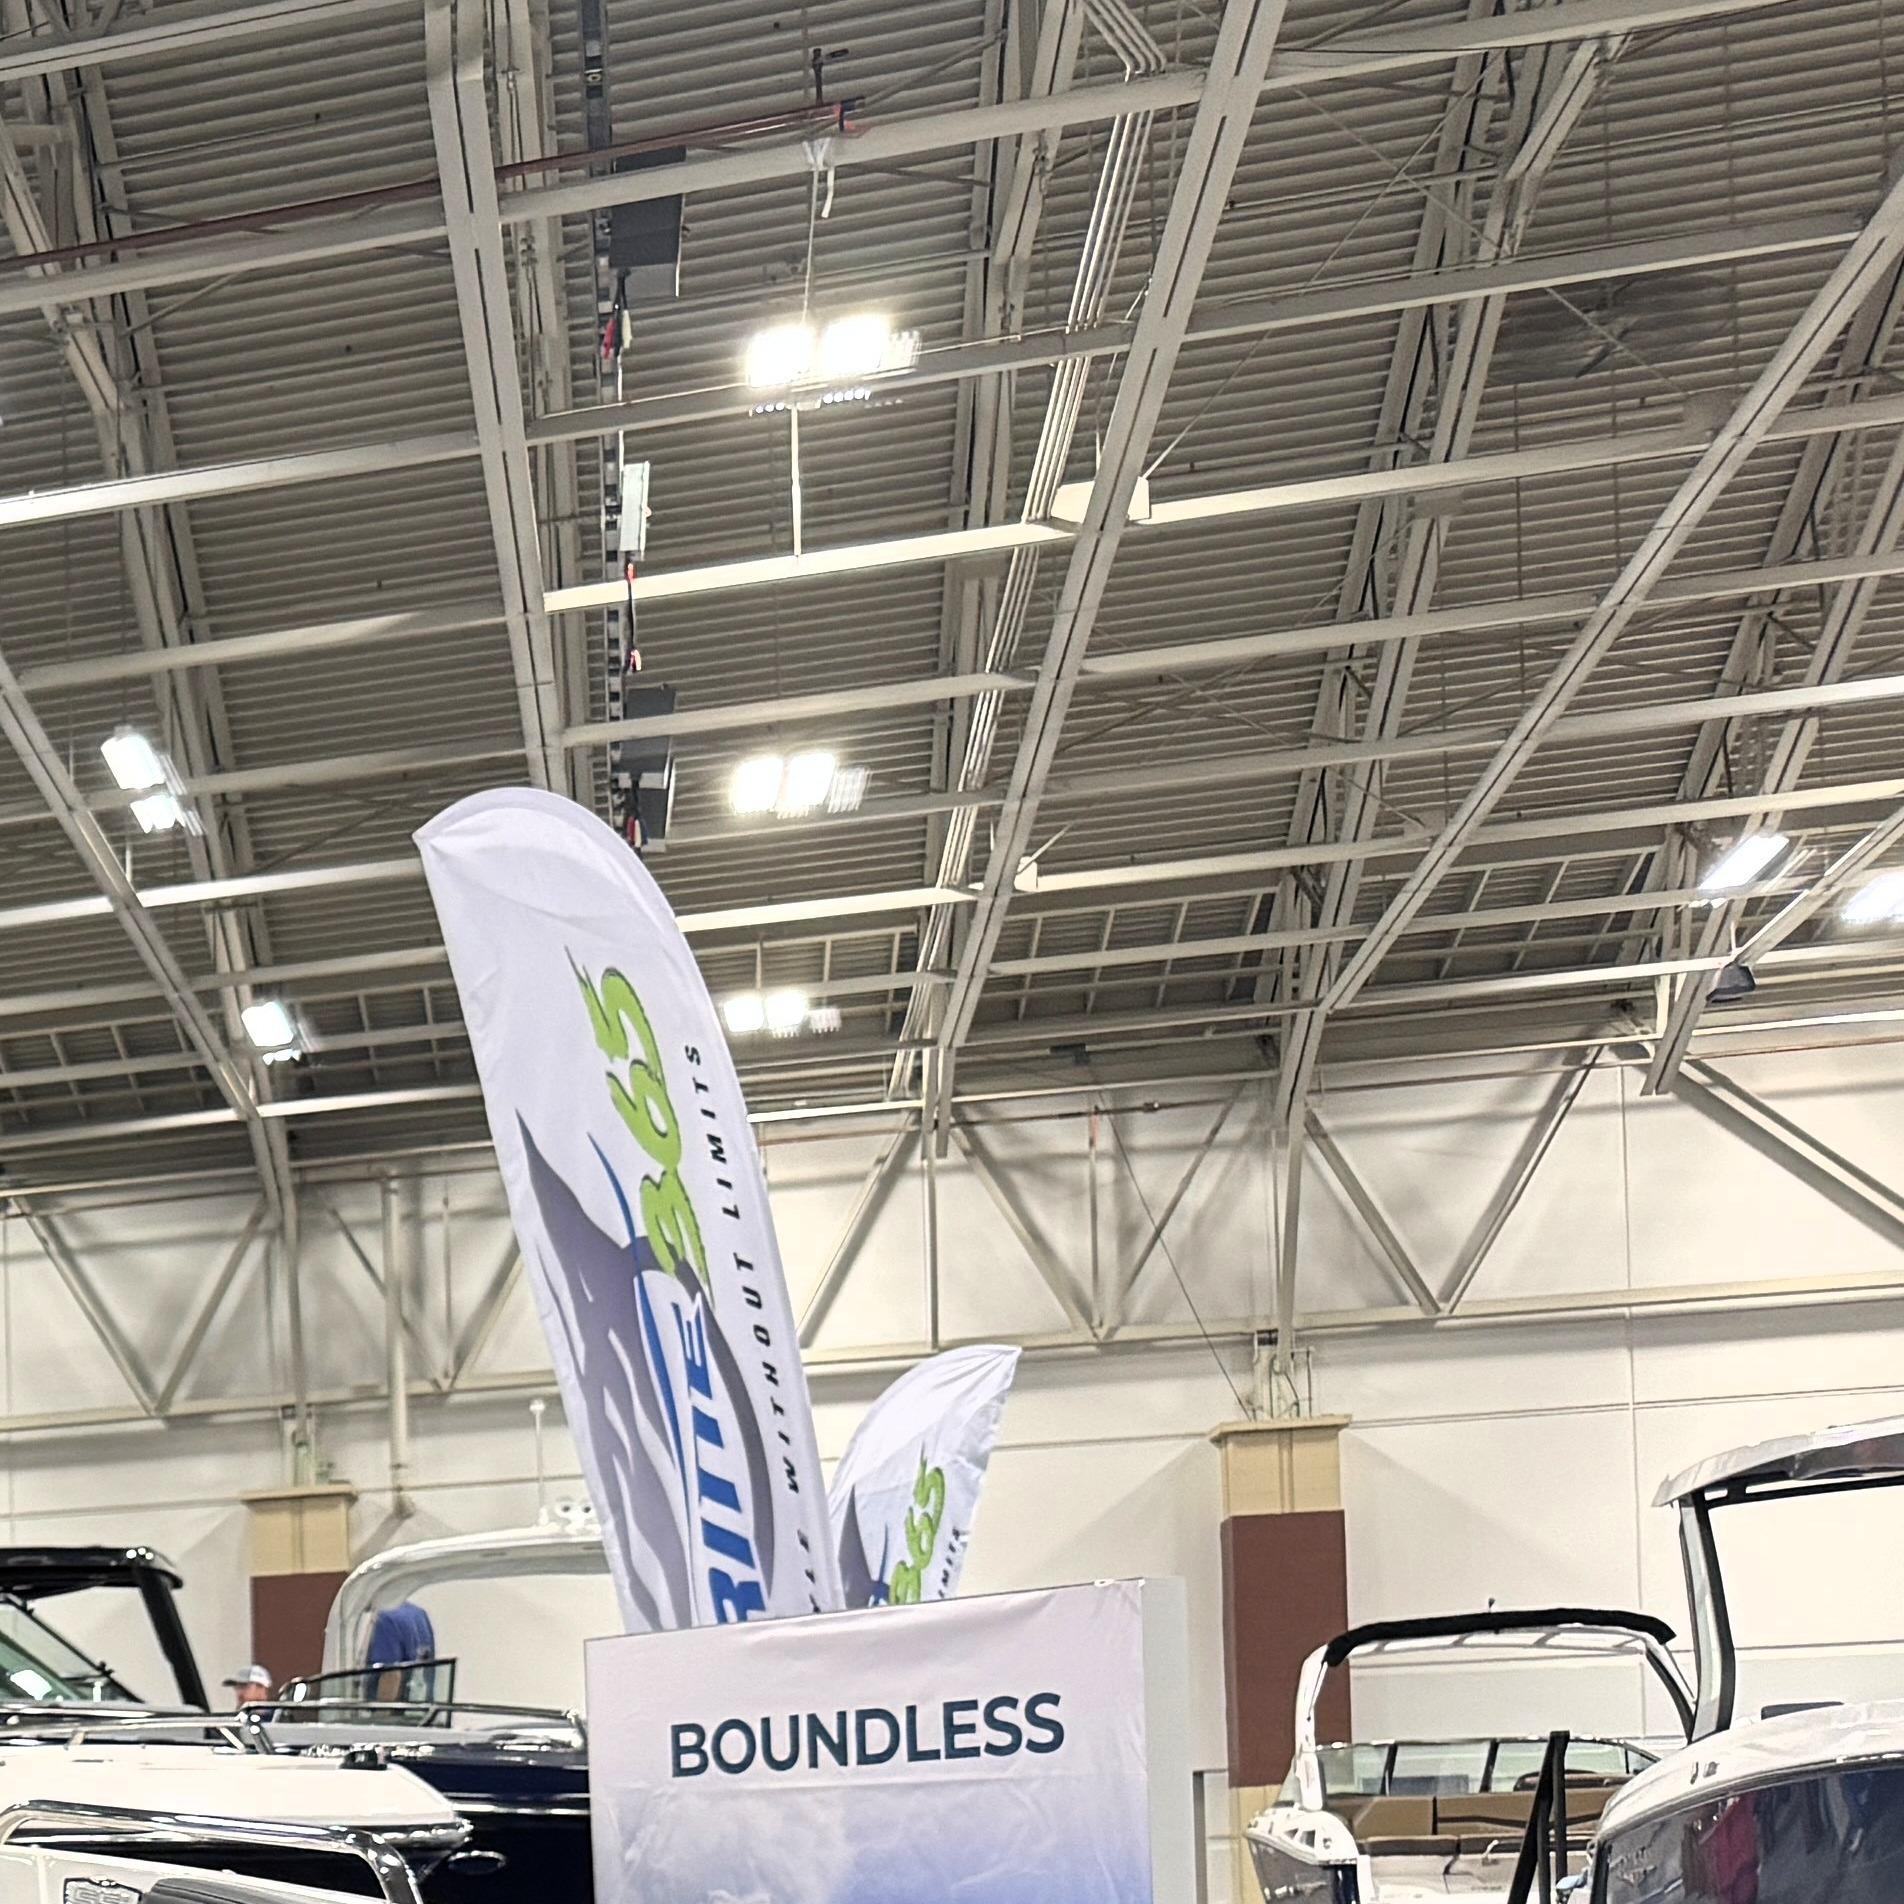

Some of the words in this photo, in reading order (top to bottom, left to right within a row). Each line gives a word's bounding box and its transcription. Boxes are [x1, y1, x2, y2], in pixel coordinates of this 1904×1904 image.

[562, 944, 716, 1314] 365
[683, 1044, 743, 1221] LIMITS
[731, 1251, 801, 1496] WITHOUT
[669, 1691, 1066, 1779] BOUNDLESS
